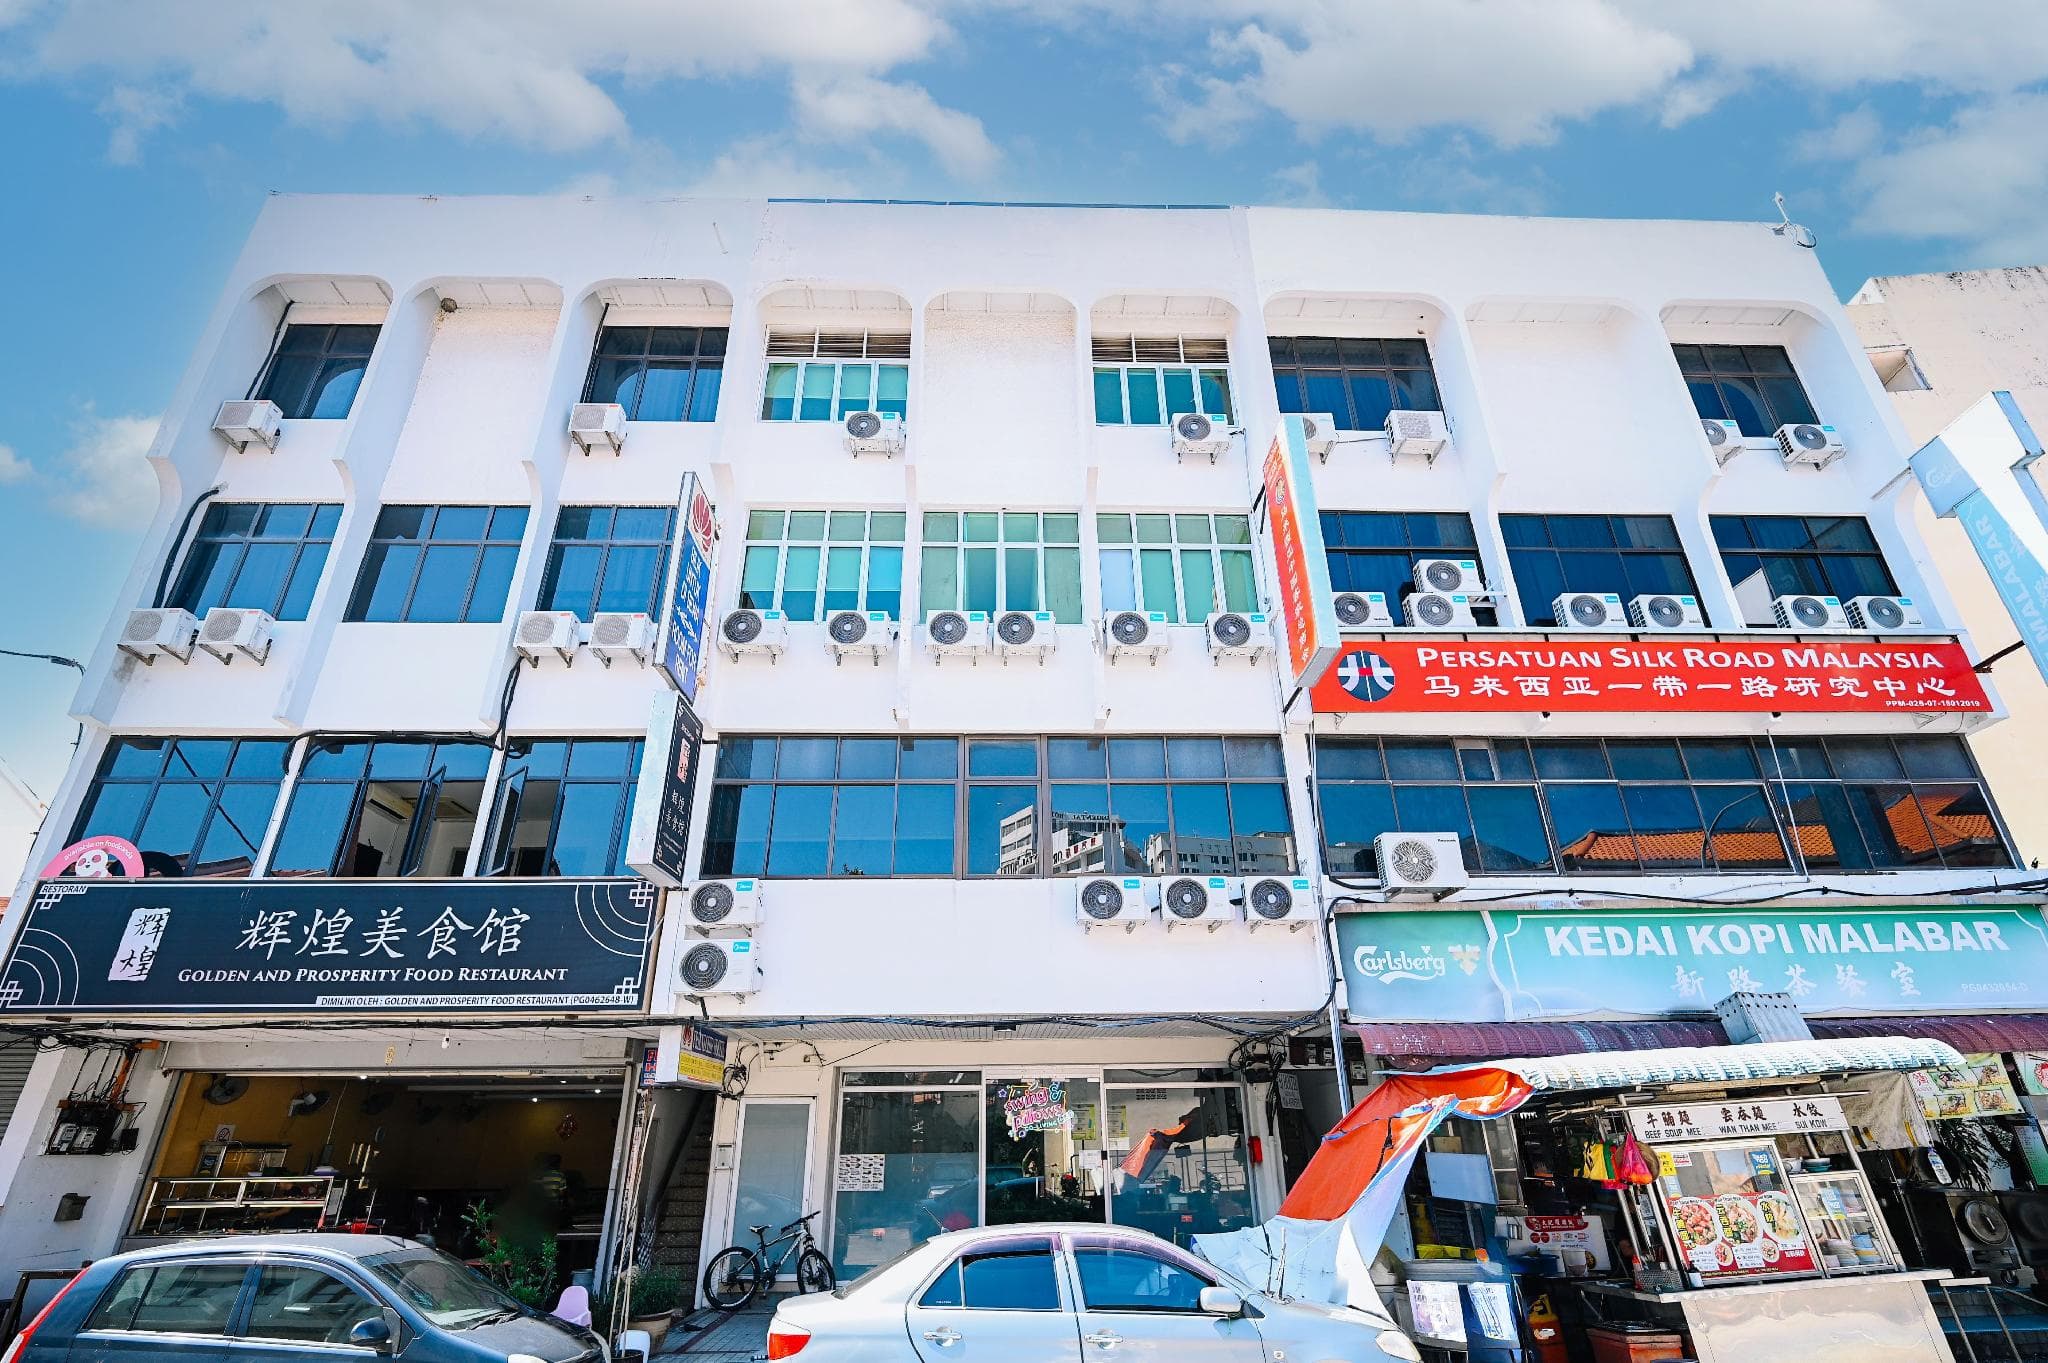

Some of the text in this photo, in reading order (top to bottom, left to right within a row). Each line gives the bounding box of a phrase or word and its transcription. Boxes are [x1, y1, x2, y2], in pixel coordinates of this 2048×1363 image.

[1416, 646, 1945, 669] PERSATUAN SILK ROAD MALAYSIA
[1423, 674, 1957, 699] 马来西亚一带一路研究中心
[42, 885, 87, 894] RESTORAN
[119, 910, 170, 979] 辉煌
[234, 905, 531, 961] 辉煌美食馆
[1544, 920, 2011, 957] KEDAI KOPI MALABAR
[178, 967, 569, 982] GOLDEN AND PROSPERITY FOOD RESTAURANT
[1353, 945, 1446, 981] Carlsberg
[384, 997, 419, 1006] GOLDEN
[420, 997, 438, 1006] AND
[440, 996, 490, 1006] PROSPERITY
[491, 996, 514, 1005] FOOD
[516, 996, 569, 1005] RESTAURANT
[1645, 1119, 1828, 1139] BEEF SOUP MEE WAN THAN MEE SUI KOW
